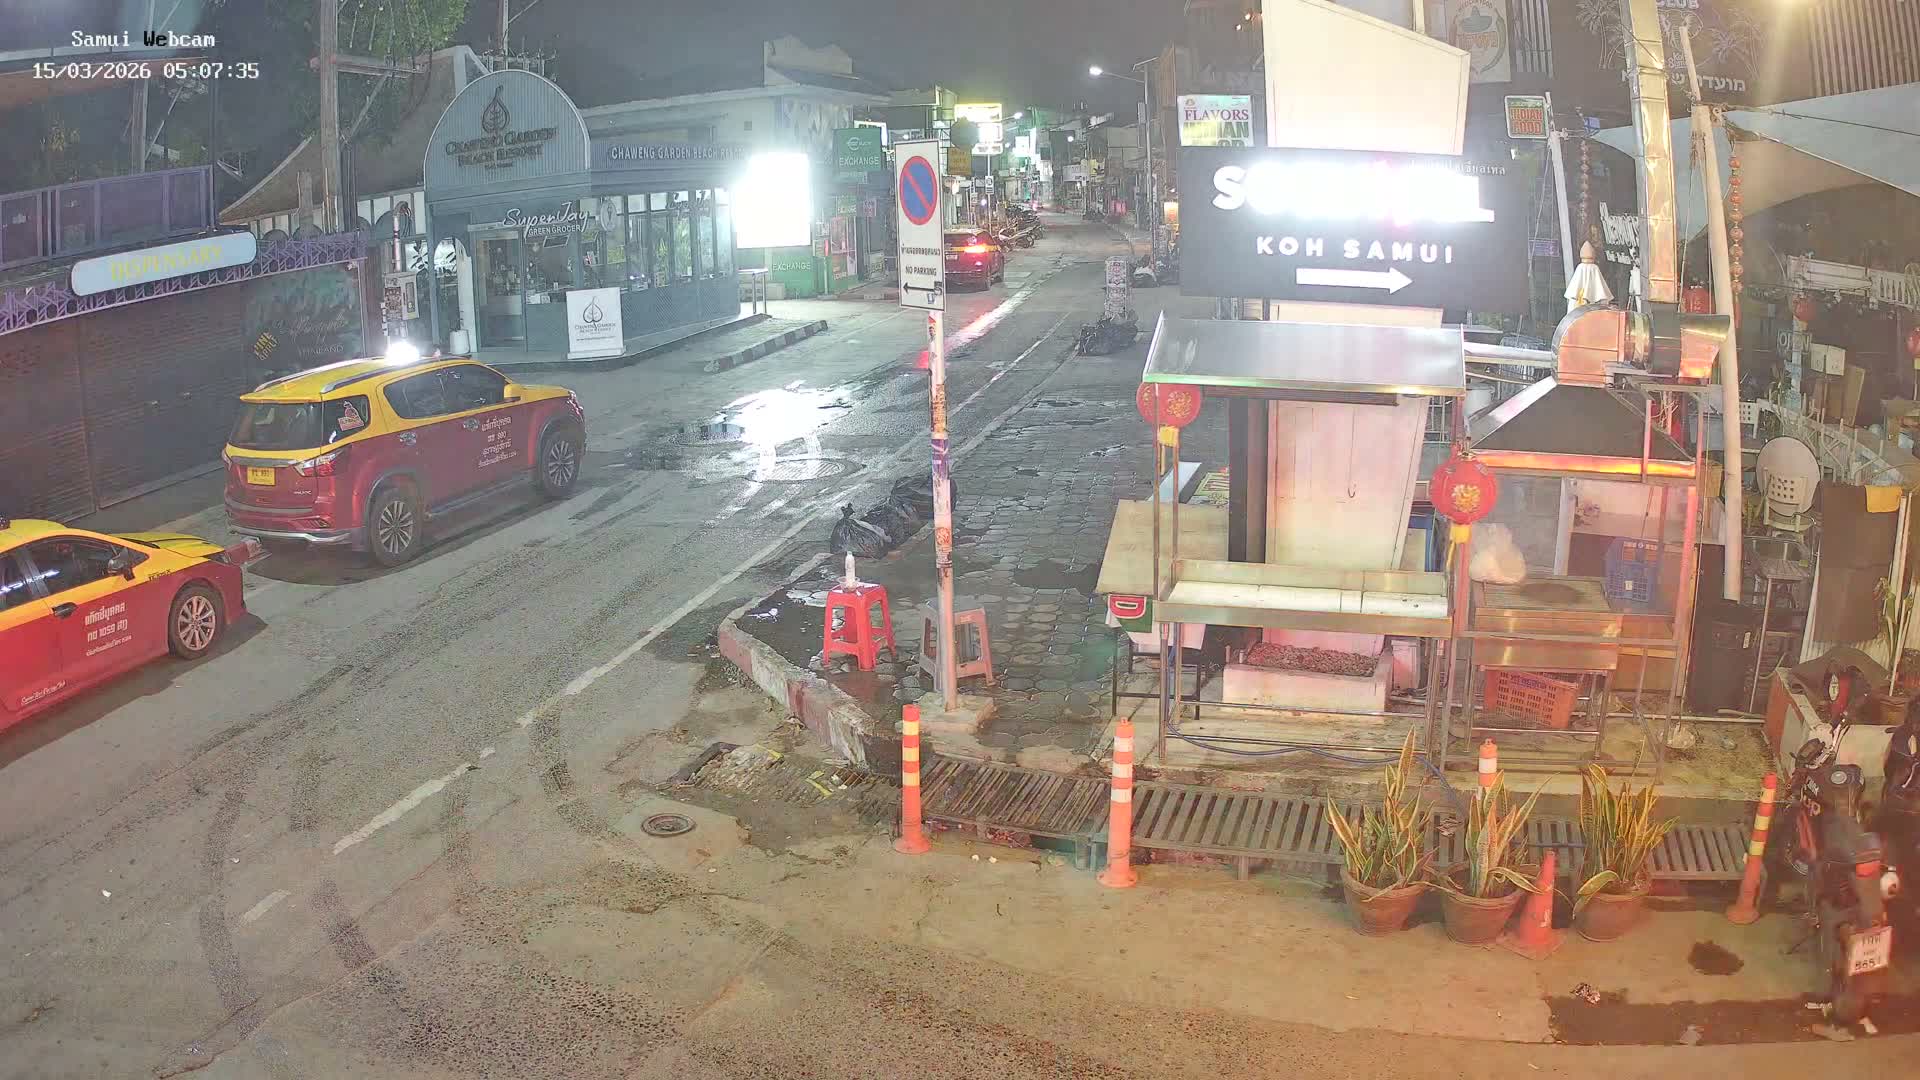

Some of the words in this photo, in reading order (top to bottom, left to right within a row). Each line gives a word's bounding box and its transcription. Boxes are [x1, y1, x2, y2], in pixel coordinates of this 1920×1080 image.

[1185, 109, 1249, 121] FLAVORS
[1510, 108, 1542, 120] INDIAN
[1512, 120, 1541, 133] FOOD
[611, 147, 655, 160] CHAWENG
[657, 147, 691, 159] GARDEN
[693, 147, 718, 159] BEACH
[839, 155, 880, 166] EXCHANGE
[528, 226, 551, 236] GREEN
[552, 223, 582, 234] GROCER
[1256, 236, 1324, 257] KOH
[1343, 239, 1452, 264] SAMUI
[111, 244, 223, 282] DISPENSARY
[771, 261, 812, 272] EXCHANGE
[905, 266, 913, 275] NO
[914, 267, 937, 277] PARKING
